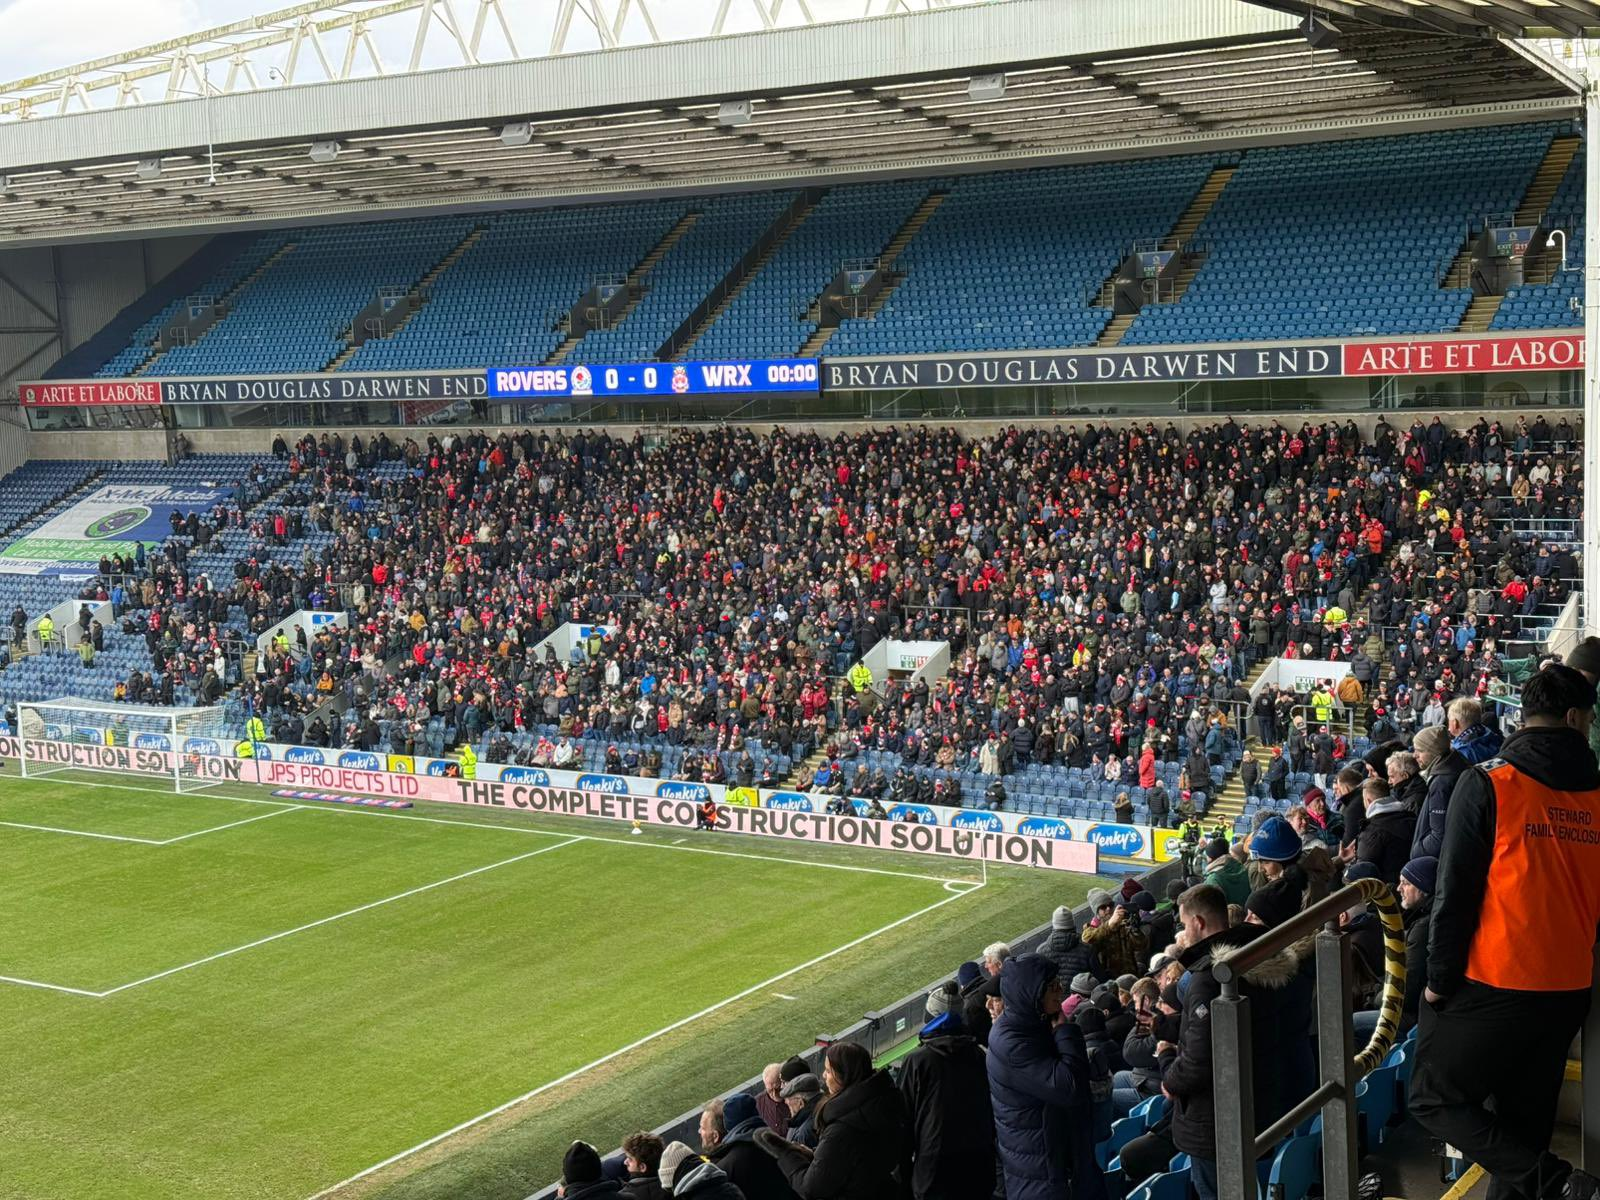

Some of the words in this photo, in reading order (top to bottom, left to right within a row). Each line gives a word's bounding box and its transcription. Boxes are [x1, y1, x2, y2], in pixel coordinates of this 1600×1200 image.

[831, 363, 920, 387] BRYAN
[936, 358, 1078, 383] DOUGLAS
[1096, 352, 1237, 379] DARWEN
[1258, 348, 1330, 374] END
[1359, 345, 1433, 371] ARTE
[1444, 343, 1480, 367] ET
[167, 383, 227, 401] BRYAN
[238, 380, 331, 400] DOUGLAS
[342, 378, 430, 398] DARWEN
[442, 376, 487, 396] END
[497, 370, 567, 391] ROVERS
[605, 368, 619, 389] 0
[643, 367, 657, 388] 0
[702, 364, 752, 387] WRX
[768, 363, 816, 383] 00:00
[42, 386, 78, 403] ARTE
[80, 385, 96, 402] ET
[101, 383, 155, 402] LABORE
[268, 763, 296, 782] JPS
[301, 766, 384, 793] PROJECTS
[390, 775, 419, 795] LTD
[457, 781, 505, 806] THE
[512, 786, 648, 820] COMPLETE
[657, 800, 881, 847] COSTRUCTION
[891, 823, 1053, 867] SOLUTION
[1548, 806, 1592, 826] STEWARD
[1093, 830, 1136, 849] Venky's
